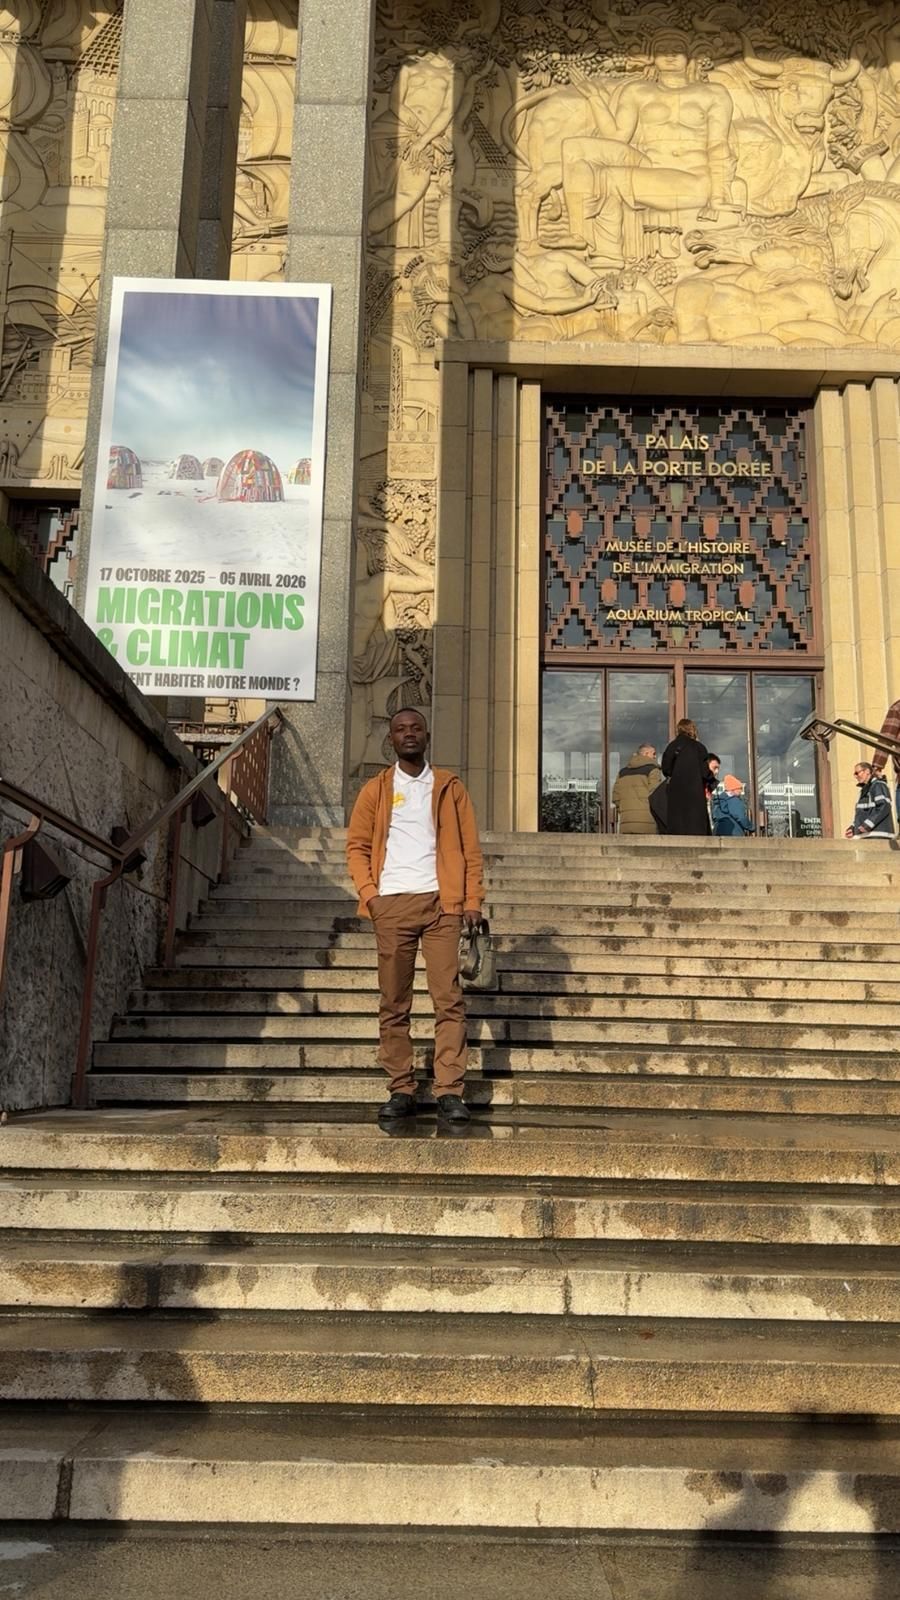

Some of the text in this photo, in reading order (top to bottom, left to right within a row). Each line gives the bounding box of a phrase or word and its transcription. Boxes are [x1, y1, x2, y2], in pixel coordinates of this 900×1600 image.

[646, 434, 709, 449] PALAIS
[583, 459, 771, 476] DE LA PORTE DORÉE
[606, 541, 750, 554] MUSÉE DE L'HISTOIRE
[613, 561, 744, 574] DE L'IMMIGRATION
[100, 568, 113, 581] 17
[115, 568, 171, 583] OCTOBRE
[175, 570, 205, 584] 2025
[219, 572, 236, 585] 05
[239, 573, 273, 587] AVRIL
[276, 574, 307, 589] 2026
[96, 587, 305, 631] MIGRATIONS
[606, 609, 753, 622] AQUARIUM TROPICAL
[126, 629, 251, 669] CLIMAT
[154, 673, 205, 689] HABITER
[207, 675, 246, 690] NOTRE
[249, 676, 291, 691] MONDE
